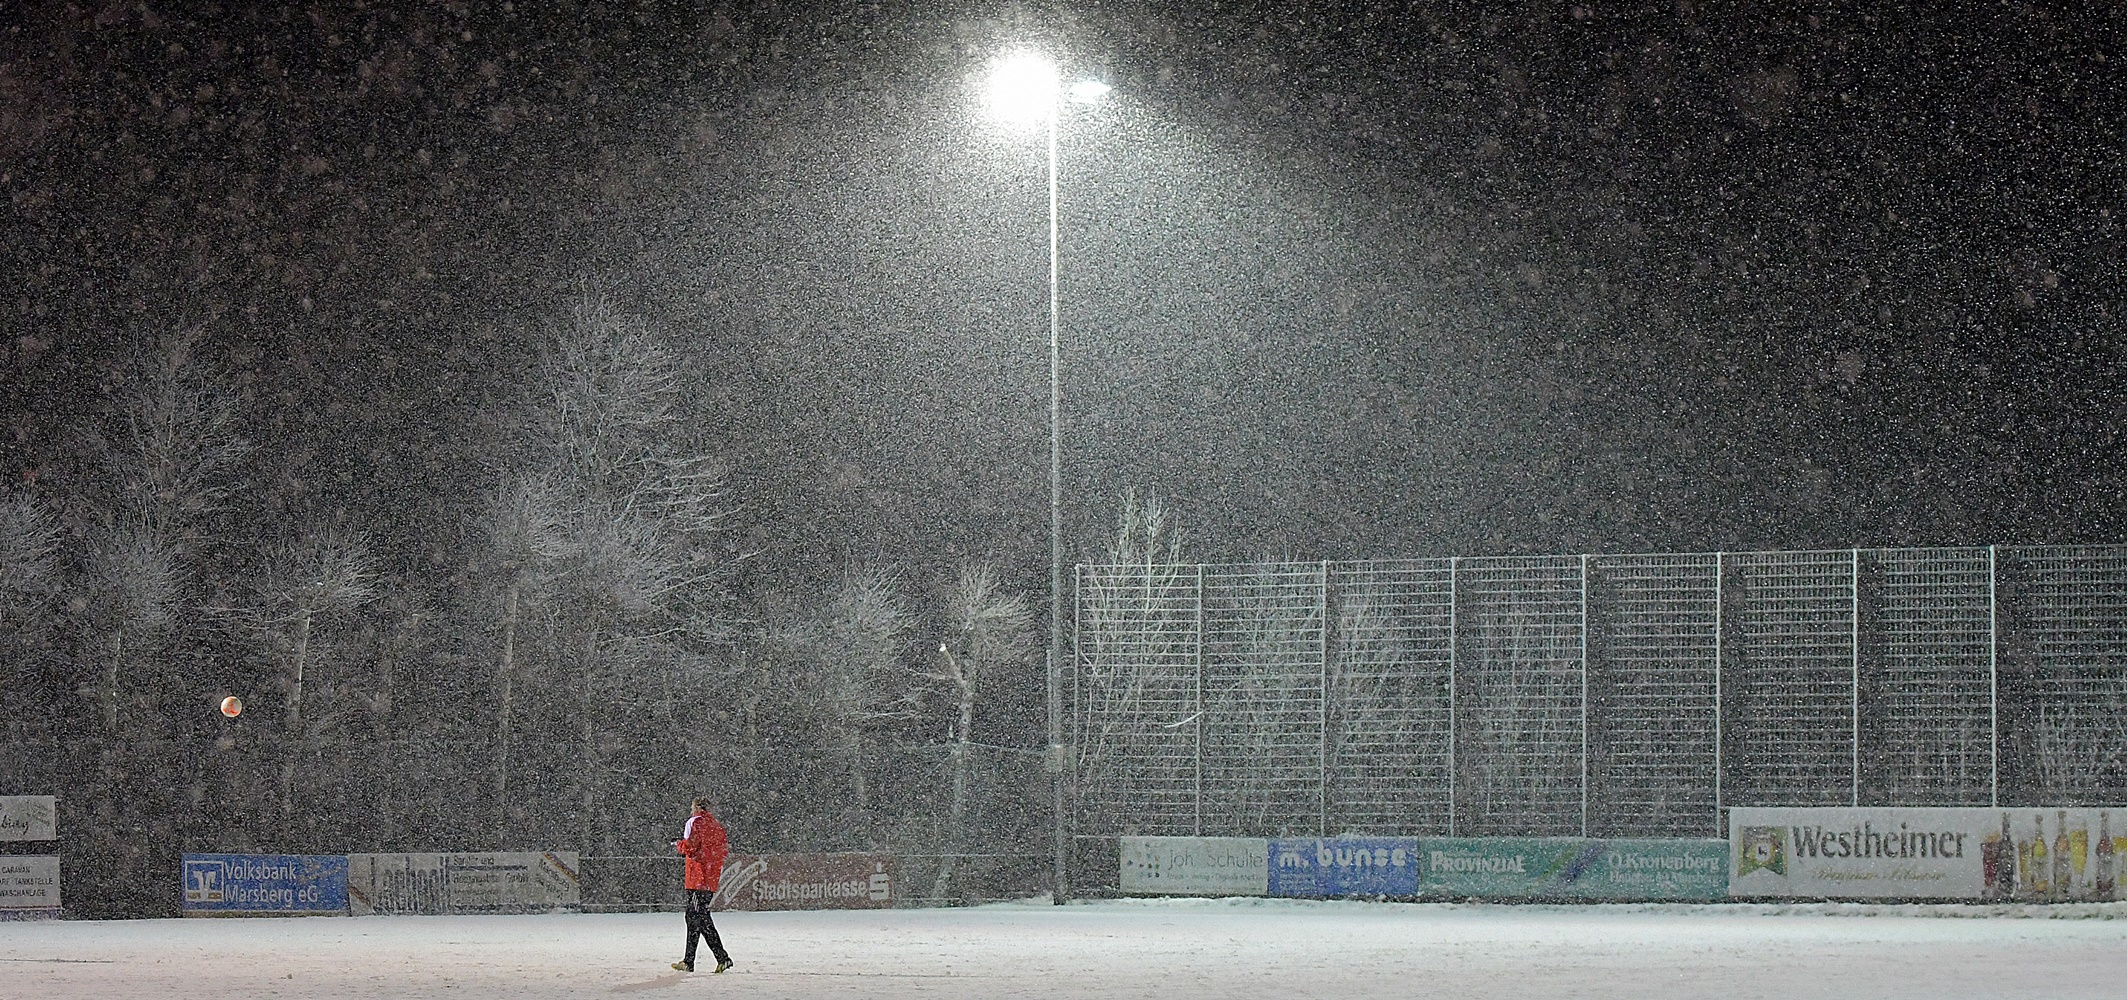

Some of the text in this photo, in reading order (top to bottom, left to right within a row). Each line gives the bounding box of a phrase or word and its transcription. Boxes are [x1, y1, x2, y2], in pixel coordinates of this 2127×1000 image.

[1792, 820, 1967, 858] Westheimer
[1316, 838, 1407, 868] bunse
[225, 859, 297, 880] Volksbank
[226, 882, 318, 907] Marsberg eG
[752, 877, 868, 900] Stadtsparkasse
